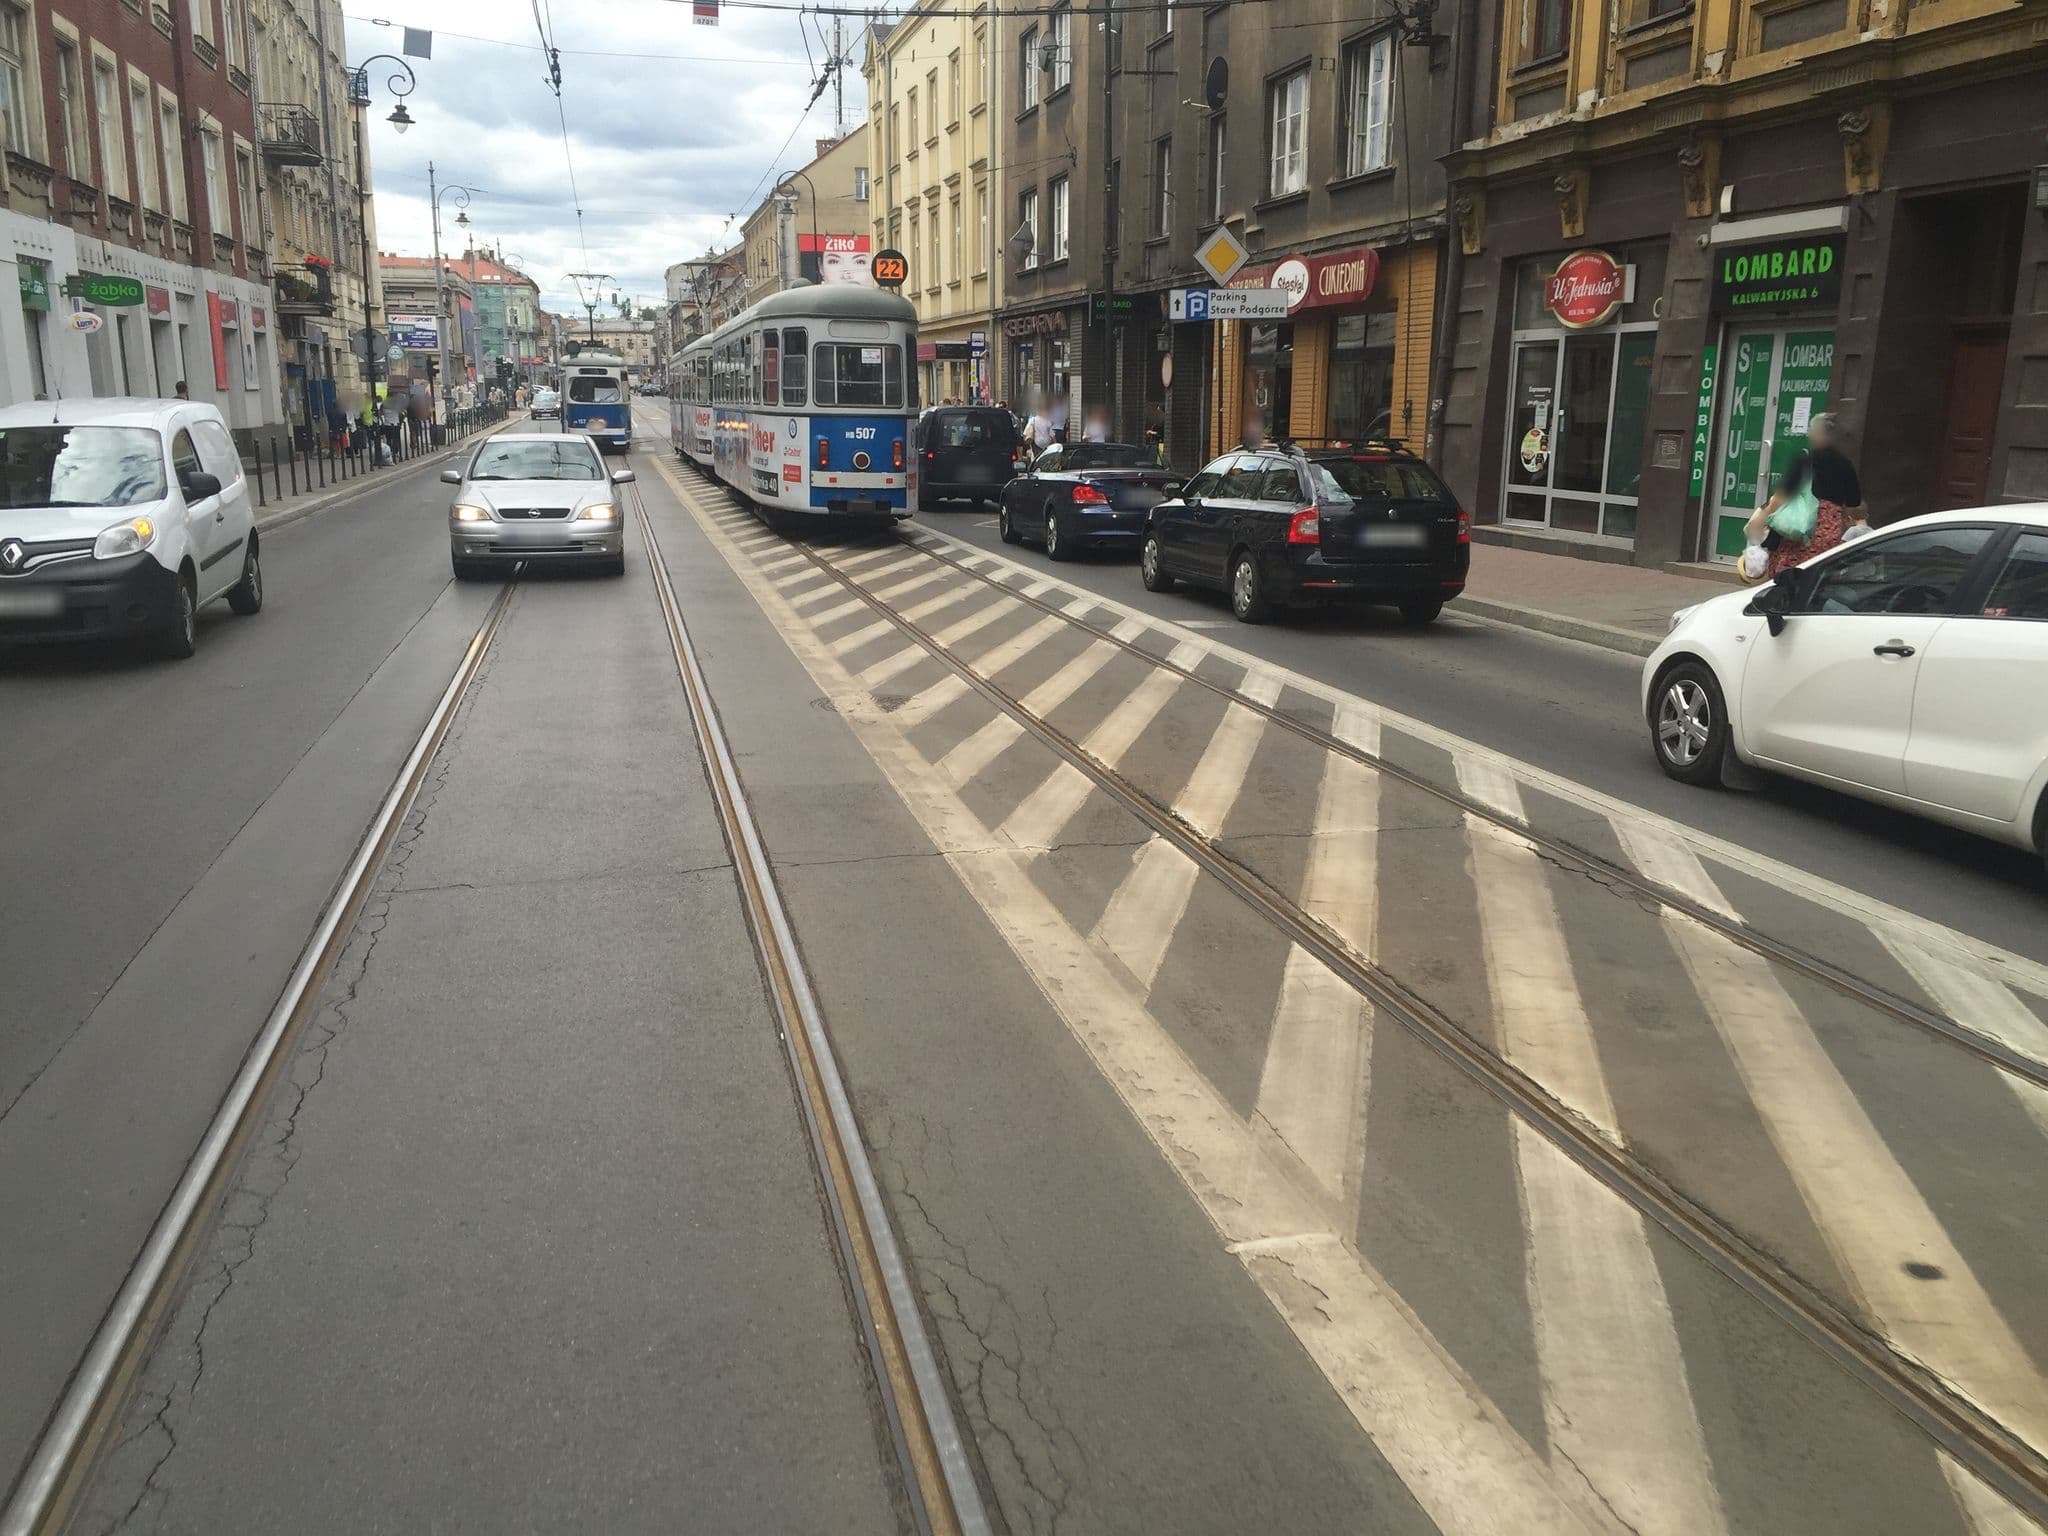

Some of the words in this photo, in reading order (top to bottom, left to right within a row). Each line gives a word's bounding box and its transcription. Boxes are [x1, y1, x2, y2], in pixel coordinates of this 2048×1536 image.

[880, 260, 900, 278] 22
[1724, 246, 1833, 283] LOMBARD
[1319, 260, 1365, 295] CUKIERNIA
[90, 282, 138, 296] żabka
[1210, 292, 1247, 304] Parking
[1732, 288, 1807, 305] KALWARYJSKA
[1811, 287, 1818, 298] 6
[1210, 305, 1236, 315] Stare
[1240, 303, 1285, 316] Podgórze
[1784, 344, 1834, 368] LOMBAR
[1692, 359, 1713, 480] LOMBARD
[1723, 342, 1750, 500] SKUP
[856, 428, 876, 439] 507
